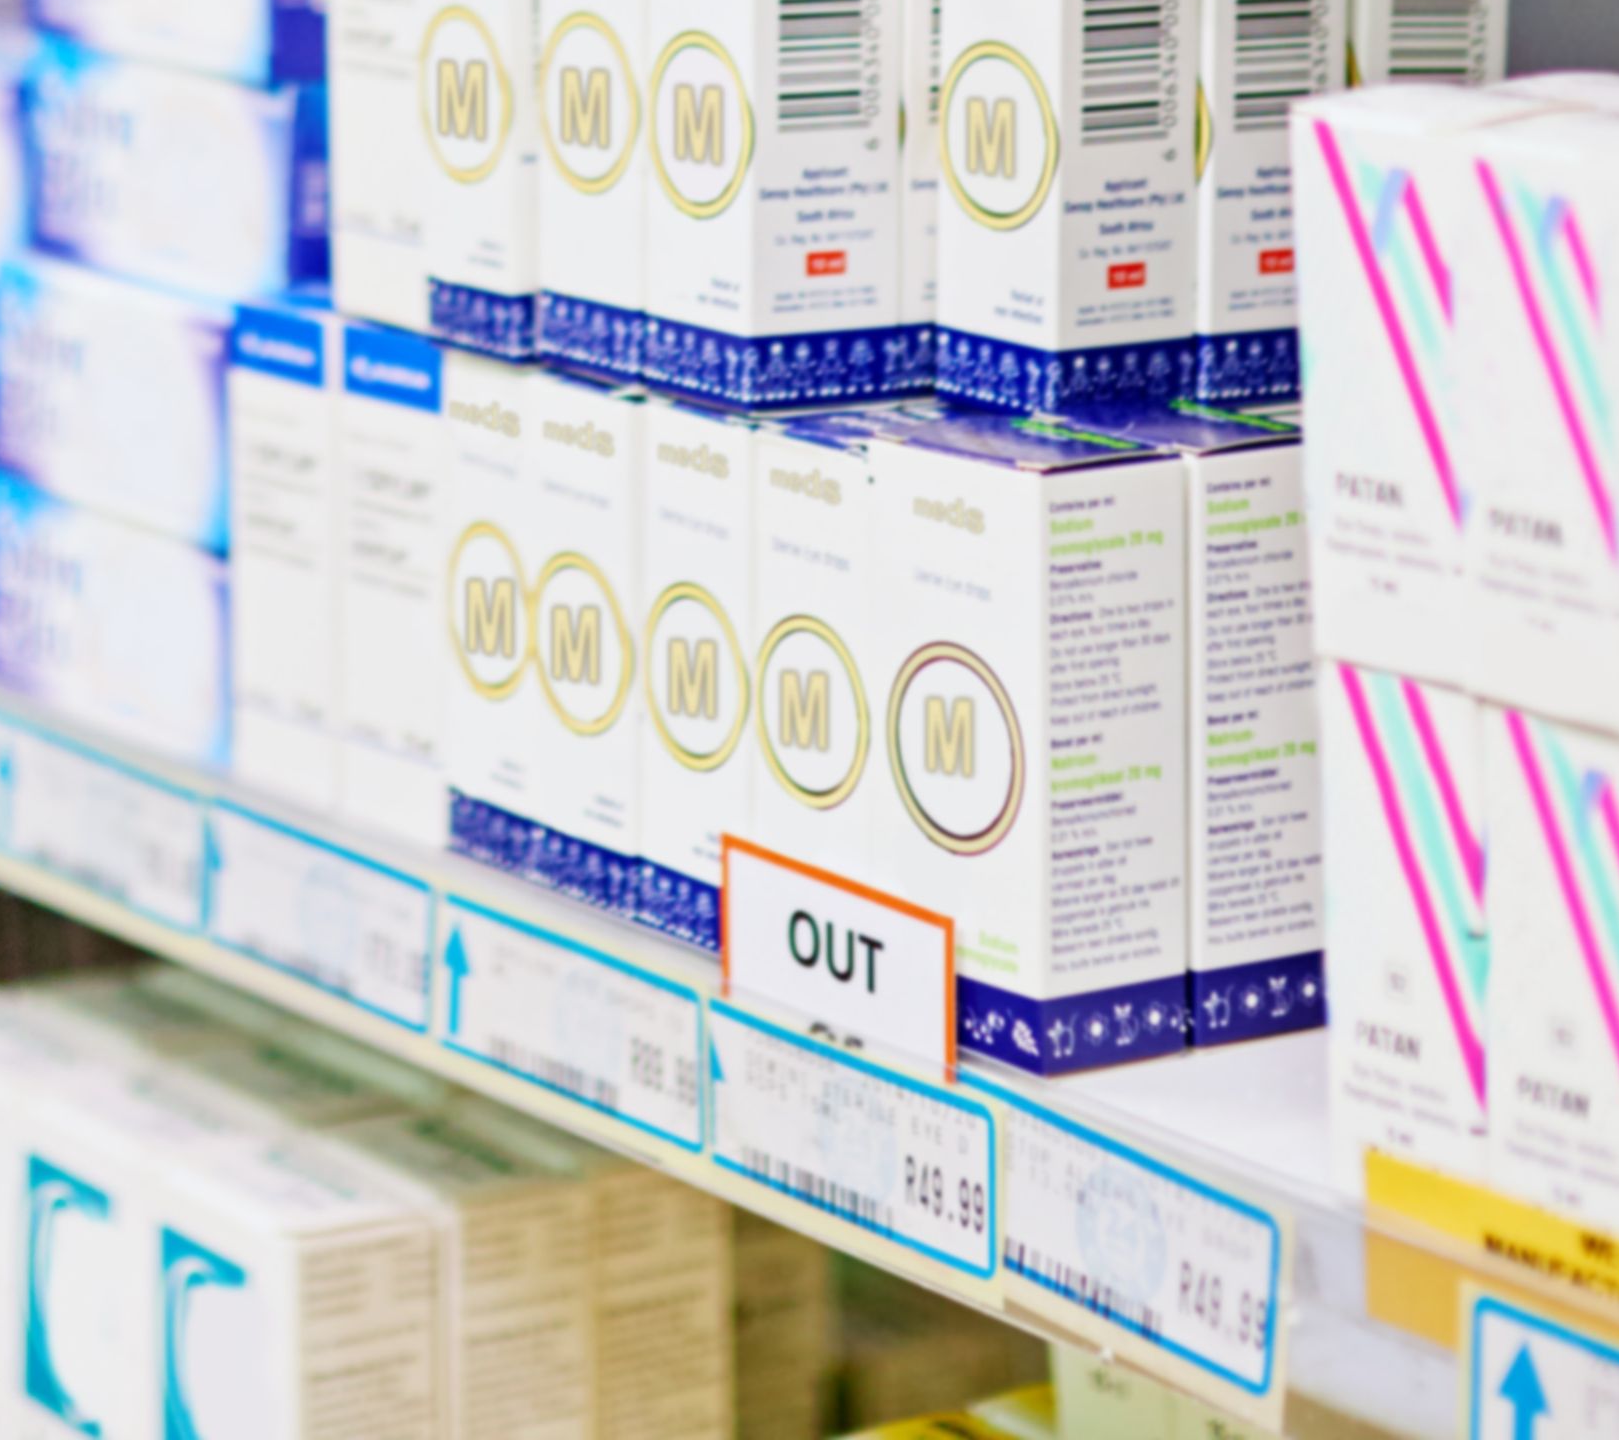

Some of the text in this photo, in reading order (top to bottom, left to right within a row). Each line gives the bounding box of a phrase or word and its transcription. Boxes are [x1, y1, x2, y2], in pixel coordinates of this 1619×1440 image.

[437, 59, 487, 143] M
[560, 66, 611, 150] M
[672, 82, 724, 167] M
[965, 96, 1016, 181] M
[449, 398, 521, 439] meds
[543, 417, 615, 459] meds
[657, 438, 730, 479] meds
[769, 465, 842, 506] meds
[912, 496, 985, 535] meds
[1335, 471, 1403, 508] PATAN
[464, 577, 516, 660] M
[550, 604, 601, 686] M
[667, 638, 718, 722] M
[778, 669, 830, 753] M
[923, 696, 975, 780] M
[786, 908, 885, 995] OUT
[1355, 1019, 1422, 1063] PATAN
[1516, 1073, 1591, 1119] PATAN
[906, 1154, 984, 1234] R49.99
[1178, 1259, 1267, 1352] R49.99
